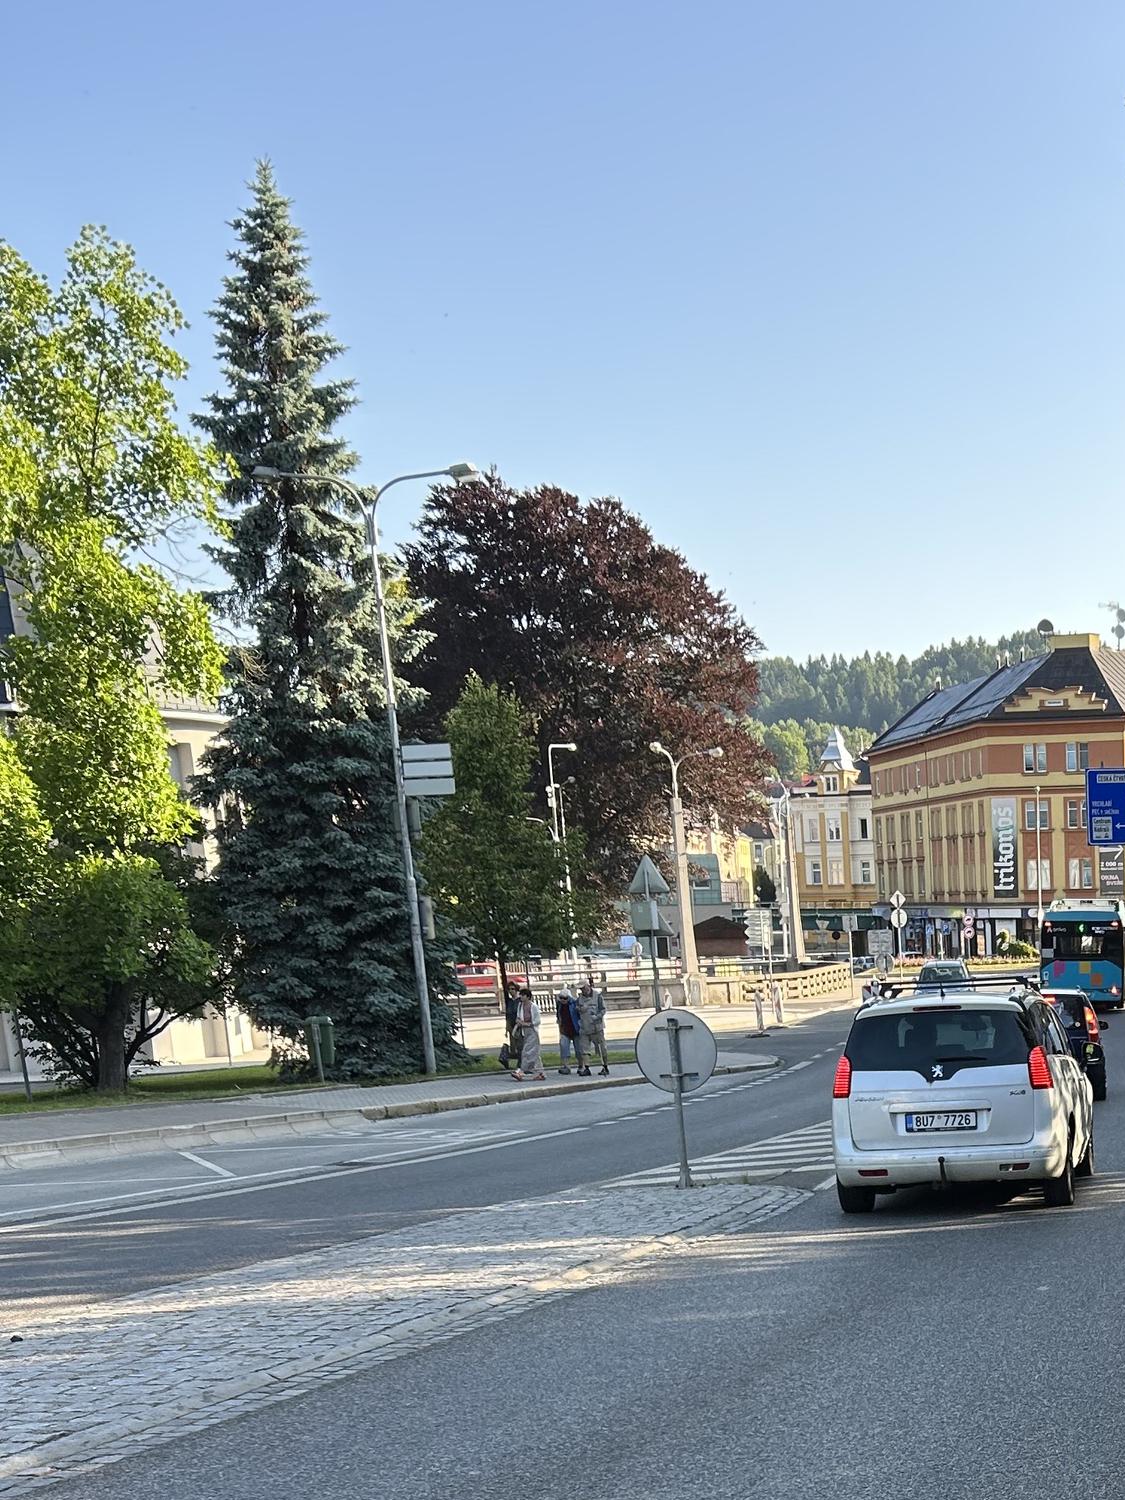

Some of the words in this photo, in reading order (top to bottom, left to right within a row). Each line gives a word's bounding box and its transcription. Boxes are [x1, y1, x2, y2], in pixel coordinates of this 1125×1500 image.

[993, 807, 1015, 891] trikonoš
[915, 1115, 935, 1127] 8U7
[944, 1113, 971, 1126] 7726
